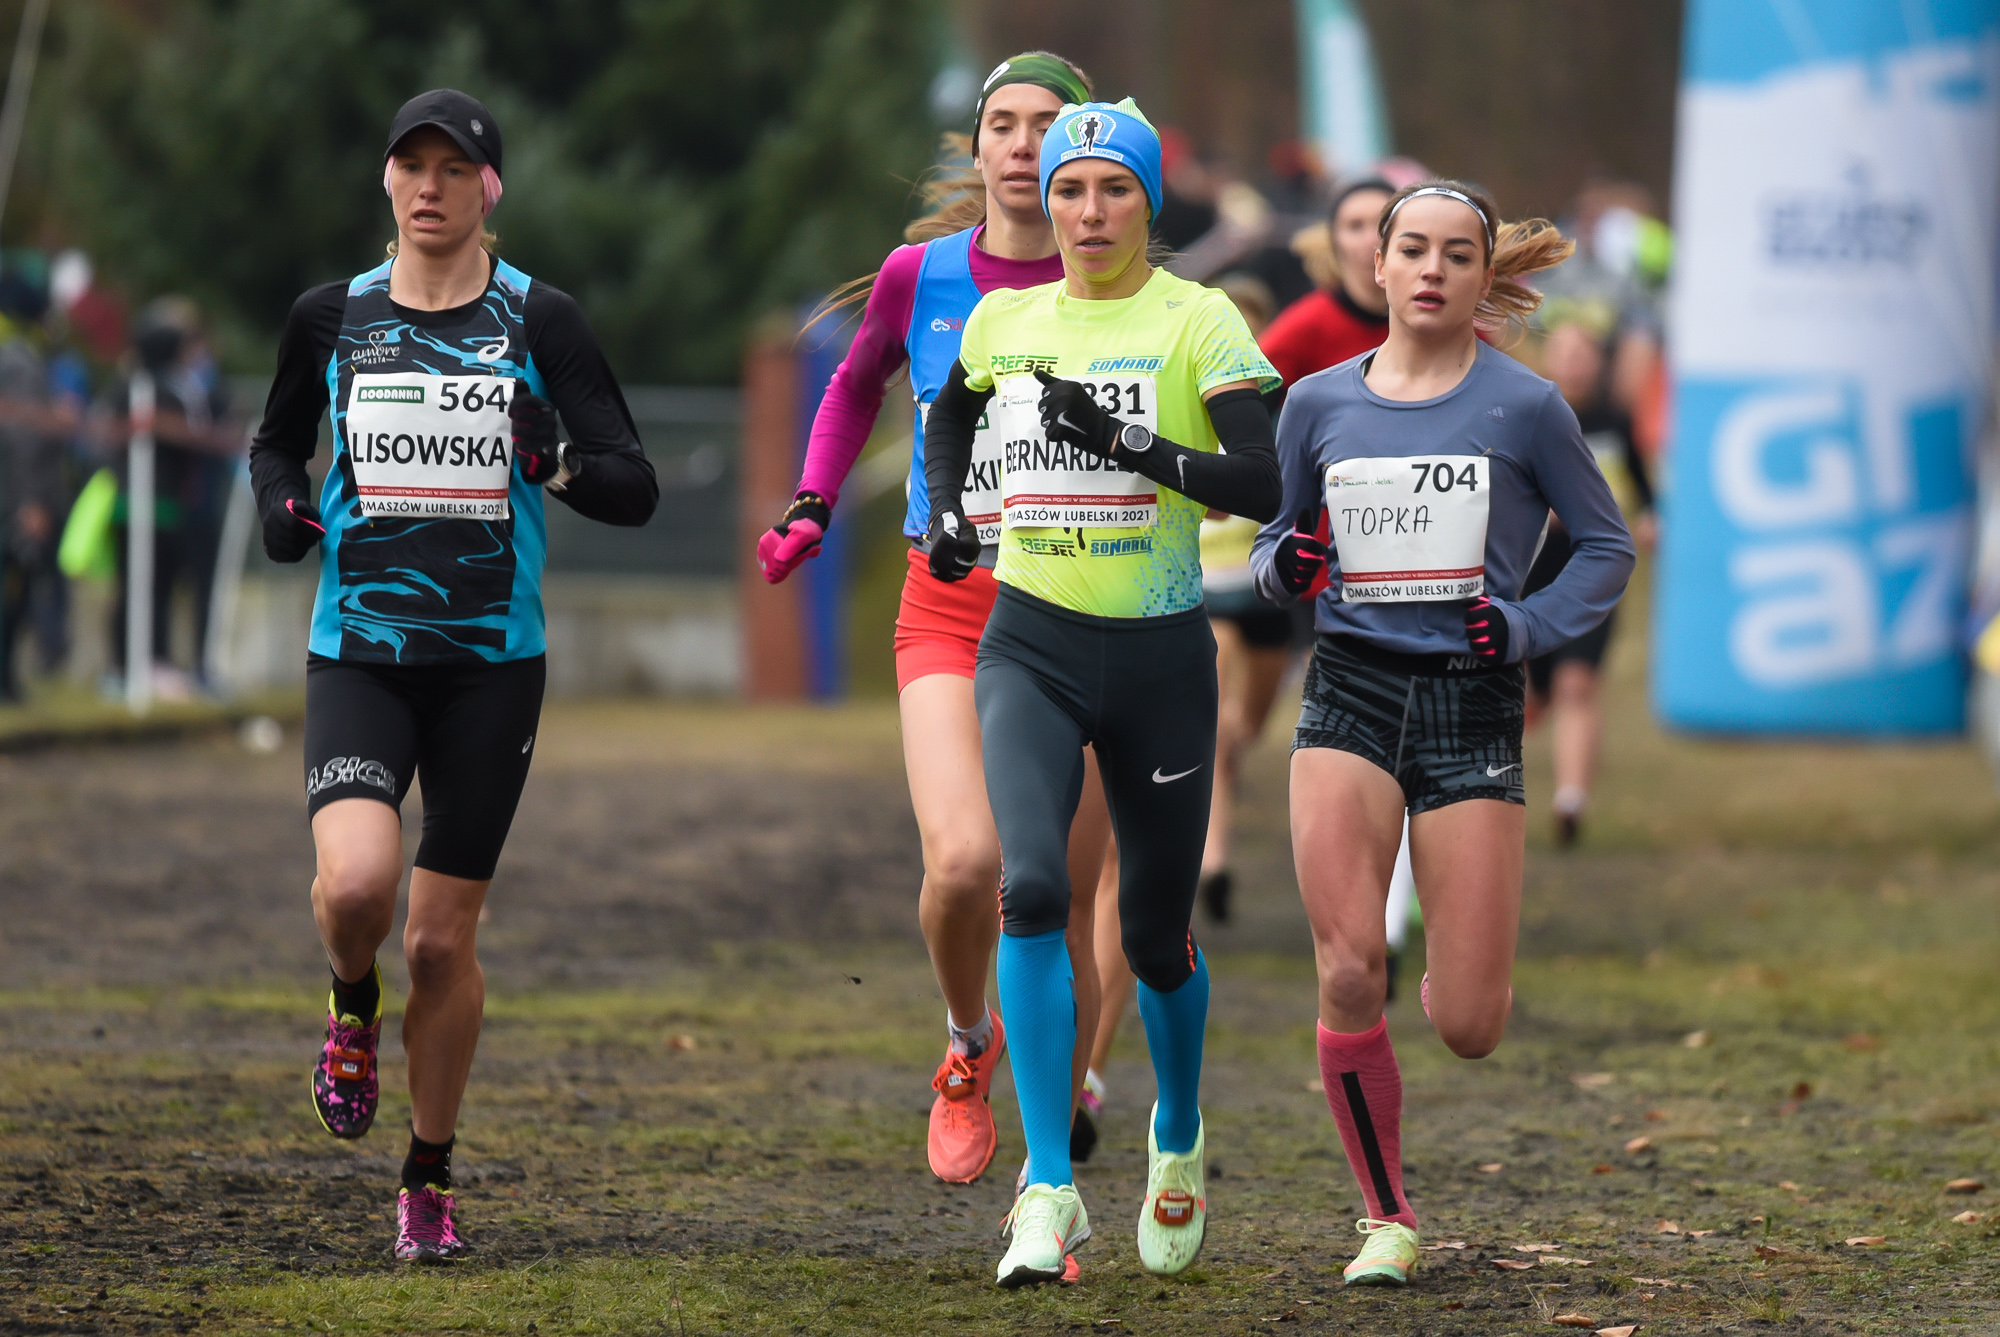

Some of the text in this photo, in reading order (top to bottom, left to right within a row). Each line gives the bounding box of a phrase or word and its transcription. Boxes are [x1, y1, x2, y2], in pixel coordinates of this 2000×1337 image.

[363, 357, 386, 365] PASTA
[361, 382, 508, 413] BOGDANKA 564
[352, 432, 509, 467] LISOWSKA
[1411, 463, 1478, 493] 704
[425, 502, 477, 515] LUBELSKI
[1064, 510, 1117, 522] LUBELSKI
[1122, 510, 1150, 521] 2021
[1341, 505, 1433, 536] TOPKA
[1090, 537, 1153, 556] SONAROL
[1405, 585, 1454, 596] LUBELSKI
[1457, 581, 1479, 595] 2021
[306, 756, 396, 802] ASICS
